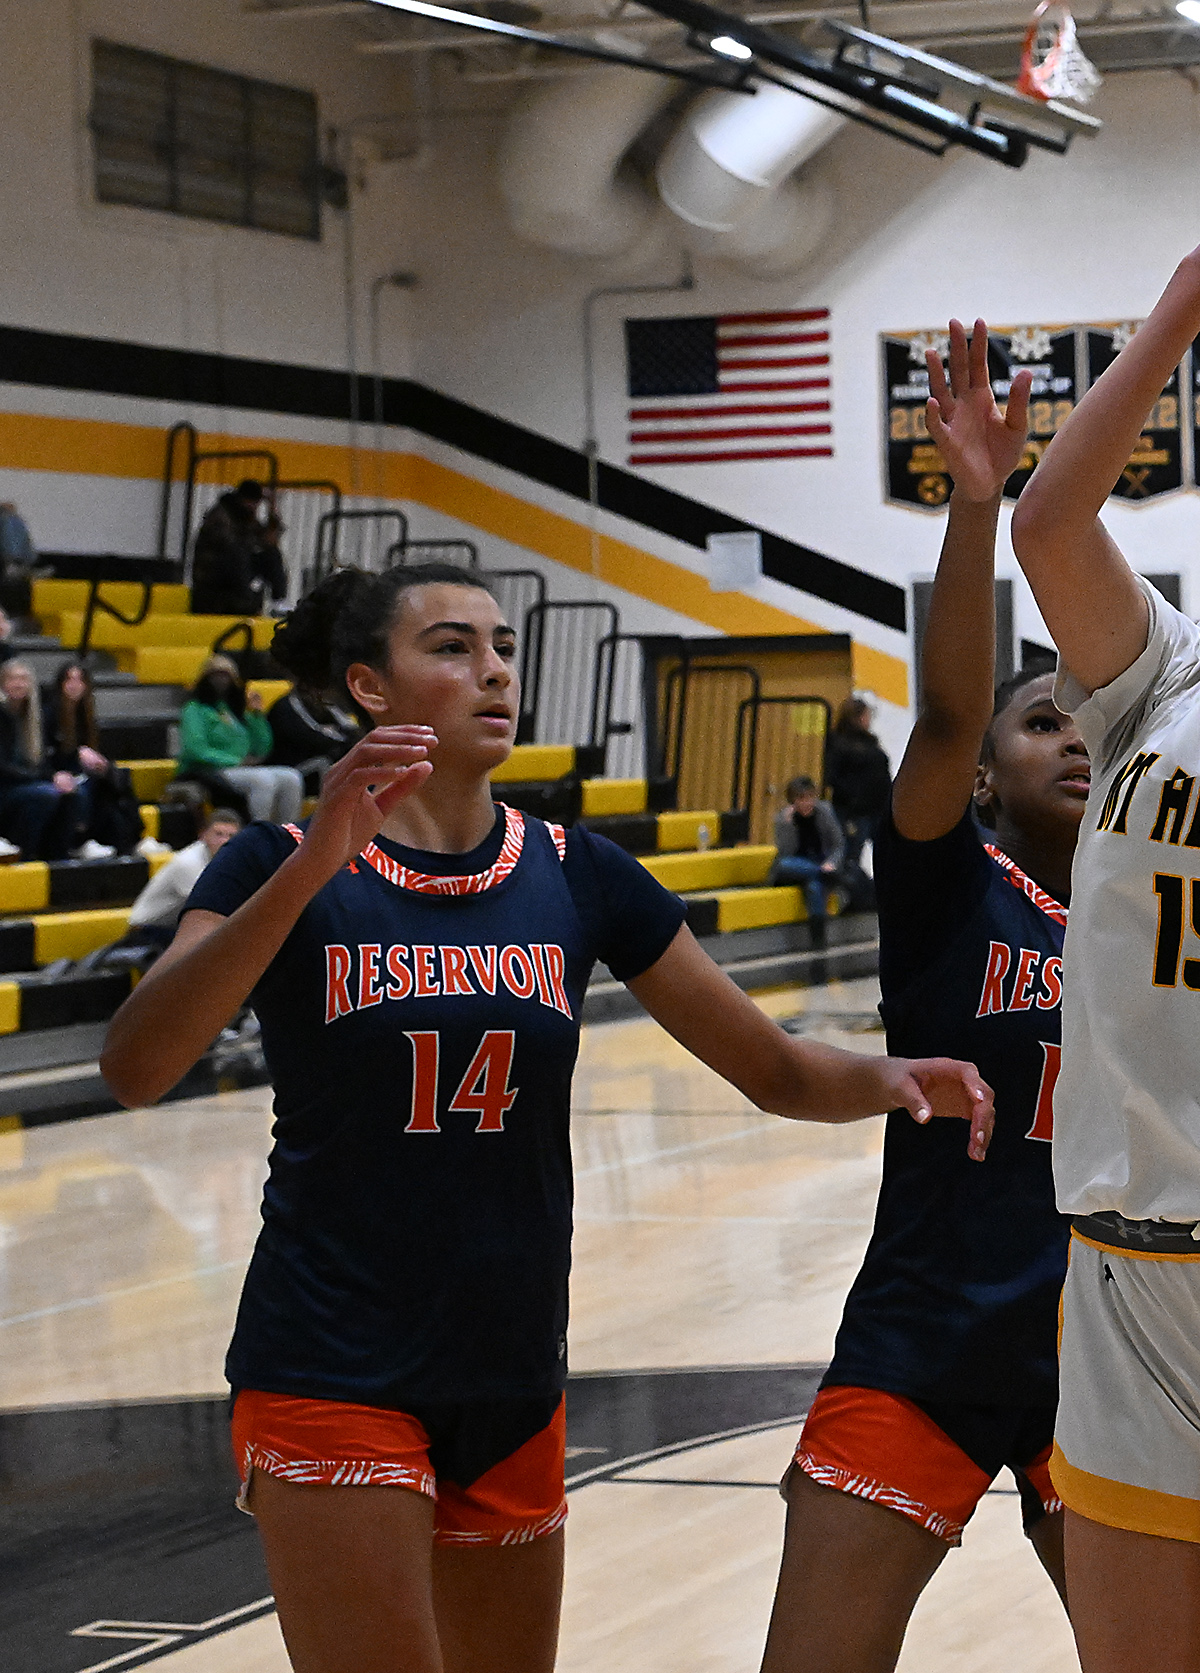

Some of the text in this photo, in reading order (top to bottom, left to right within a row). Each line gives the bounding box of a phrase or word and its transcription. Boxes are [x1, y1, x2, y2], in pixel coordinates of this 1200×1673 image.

[324, 943, 573, 1024] RESERVOIR
[975, 940, 1063, 1018] RES
[402, 1029, 520, 1133] 14
